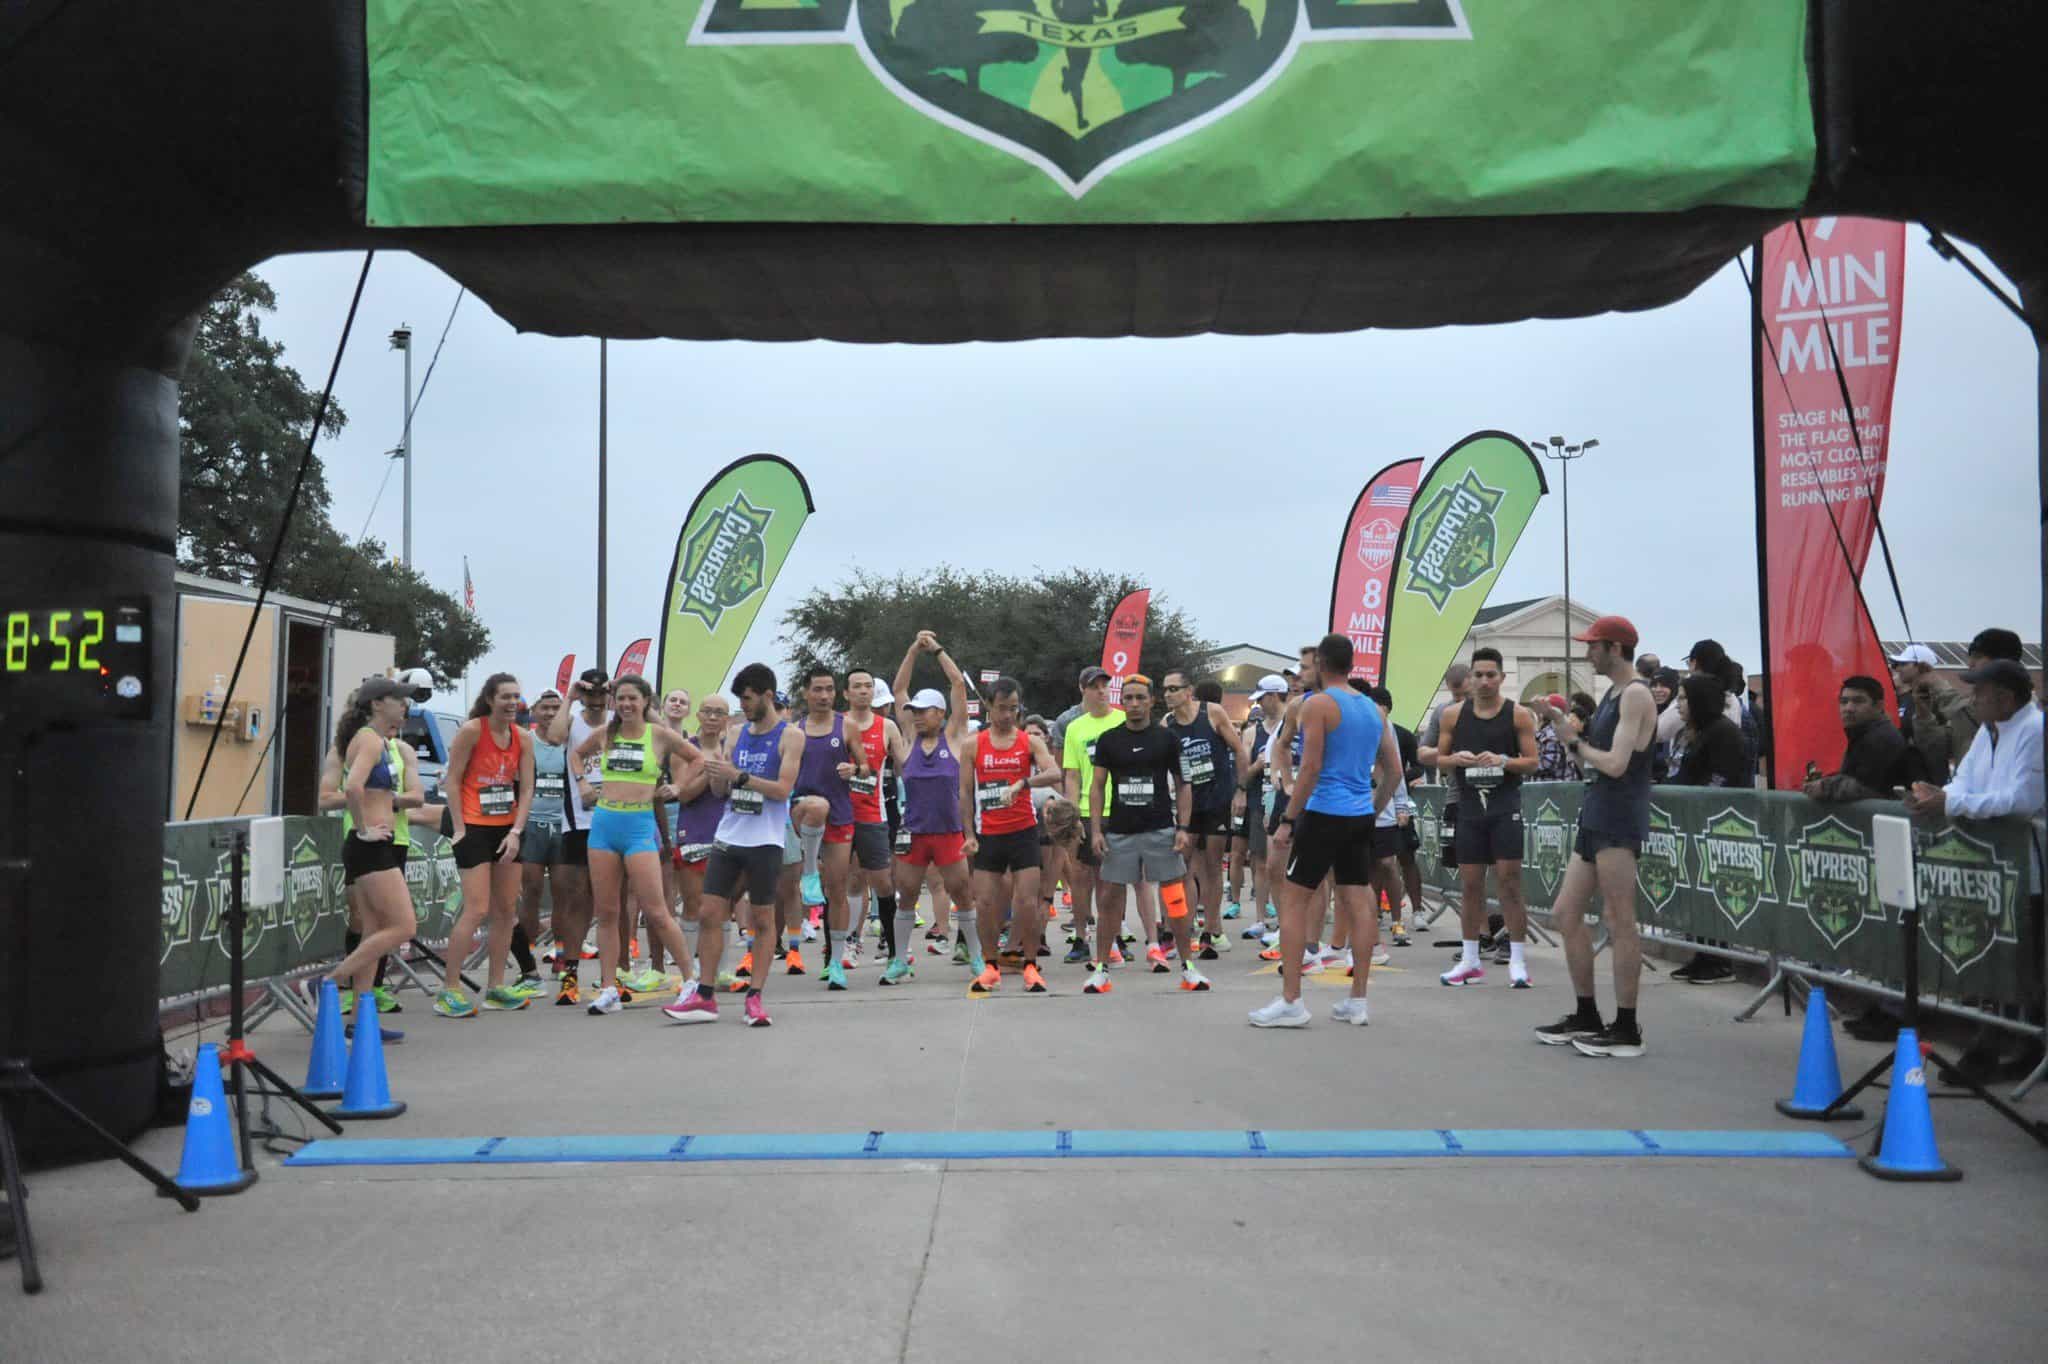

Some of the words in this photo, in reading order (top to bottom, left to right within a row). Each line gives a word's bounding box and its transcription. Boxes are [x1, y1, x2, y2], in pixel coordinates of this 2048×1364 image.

[1018, 15, 1138, 43] TEXAS
[1780, 250, 1887, 309] MIN
[1779, 316, 1890, 376] MILE
[1778, 409, 1827, 429] STAGE
[1778, 431, 1807, 449] THE
[1811, 427, 1850, 446] FLAG
[1780, 450, 1824, 469] MOST
[1780, 466, 1857, 489] RESEMBLES
[1781, 486, 1851, 508] RUNNING
[1362, 578, 1382, 609] 8
[1349, 611, 1385, 634] MIN
[1113, 651, 1128, 673] 9
[1706, 838, 1763, 881] CYPRESS
[1801, 849, 1869, 896] CYPRESS
[1915, 861, 2001, 915] CYPRESS
